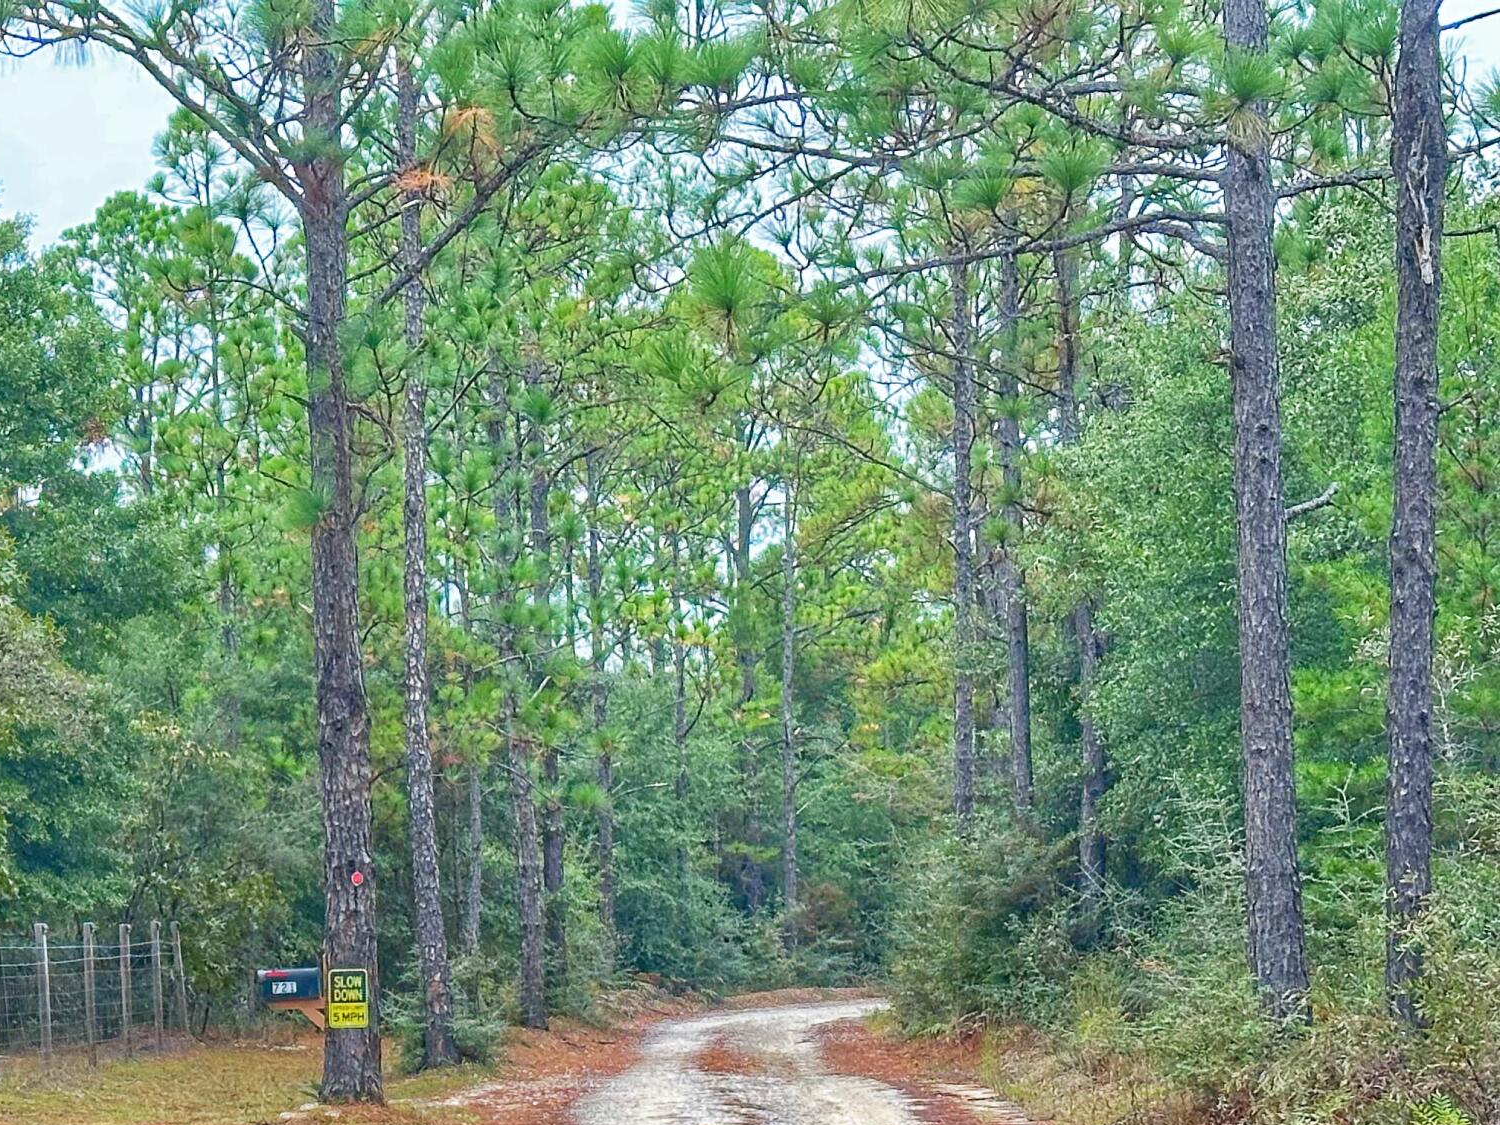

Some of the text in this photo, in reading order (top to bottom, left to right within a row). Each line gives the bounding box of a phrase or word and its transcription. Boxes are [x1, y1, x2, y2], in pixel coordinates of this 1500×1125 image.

[334, 976, 362, 988] SLOW
[274, 983, 294, 993] 721
[334, 989, 363, 1001] DOWN
[333, 1011, 365, 1022] 5 MPH
